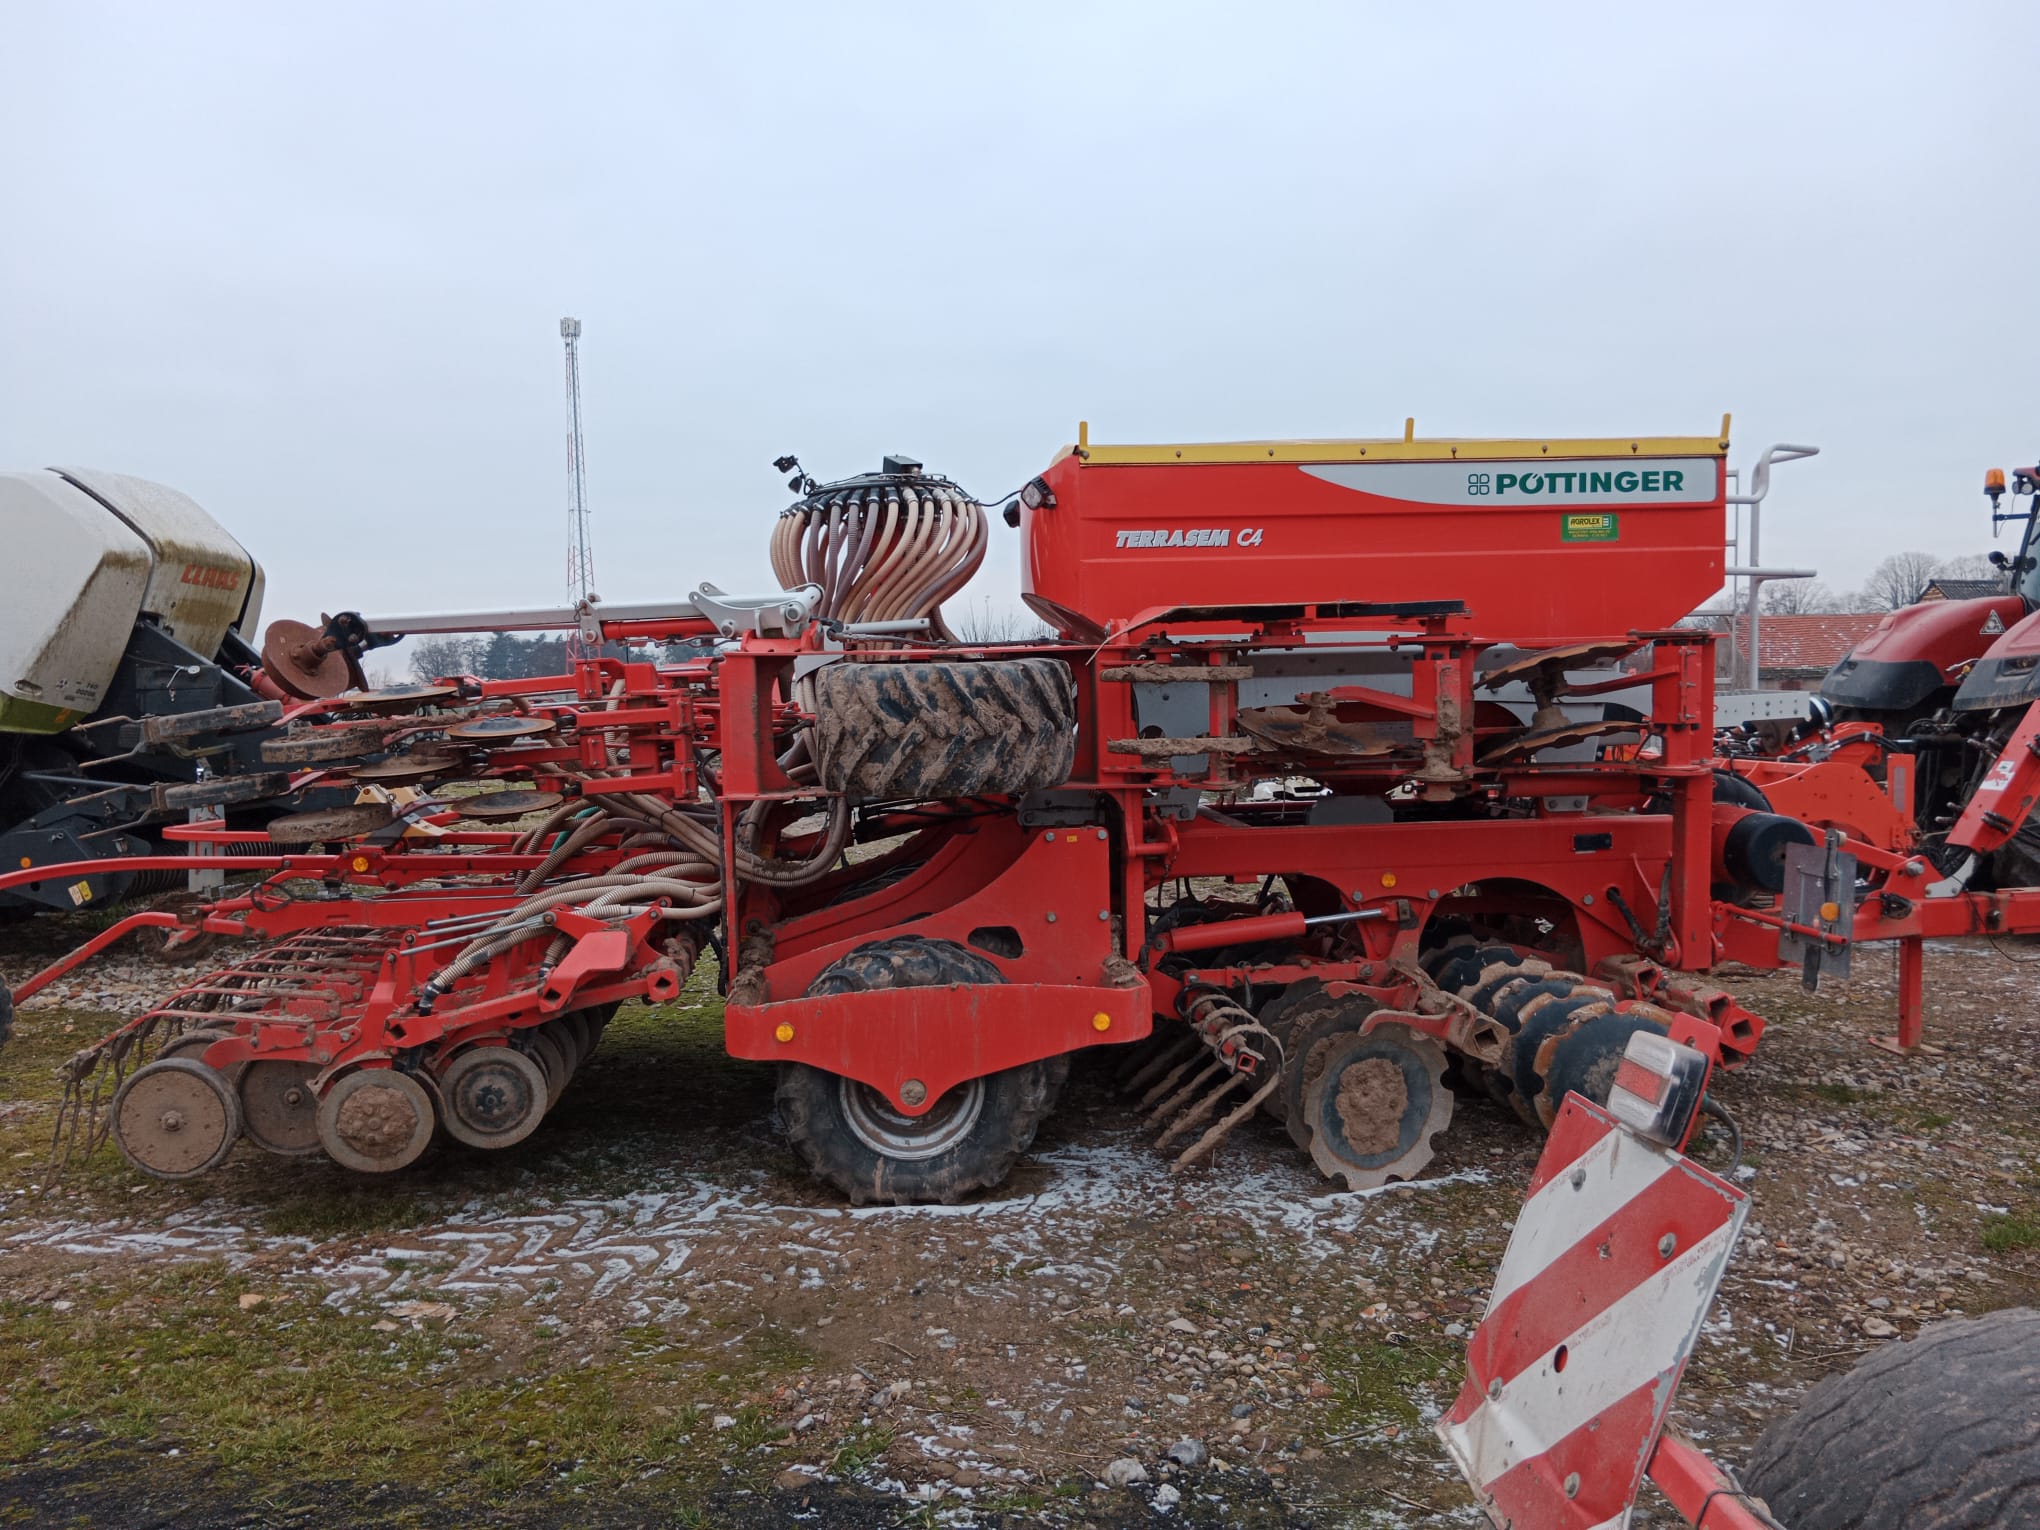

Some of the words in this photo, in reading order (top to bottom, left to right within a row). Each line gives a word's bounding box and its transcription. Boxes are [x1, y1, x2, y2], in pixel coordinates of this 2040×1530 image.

[1570, 518, 1601, 526] AGROLEX
[1115, 529, 1230, 548] TERRASEM
[1236, 528, 1264, 547] C4
[181, 563, 240, 591] CLAAS
